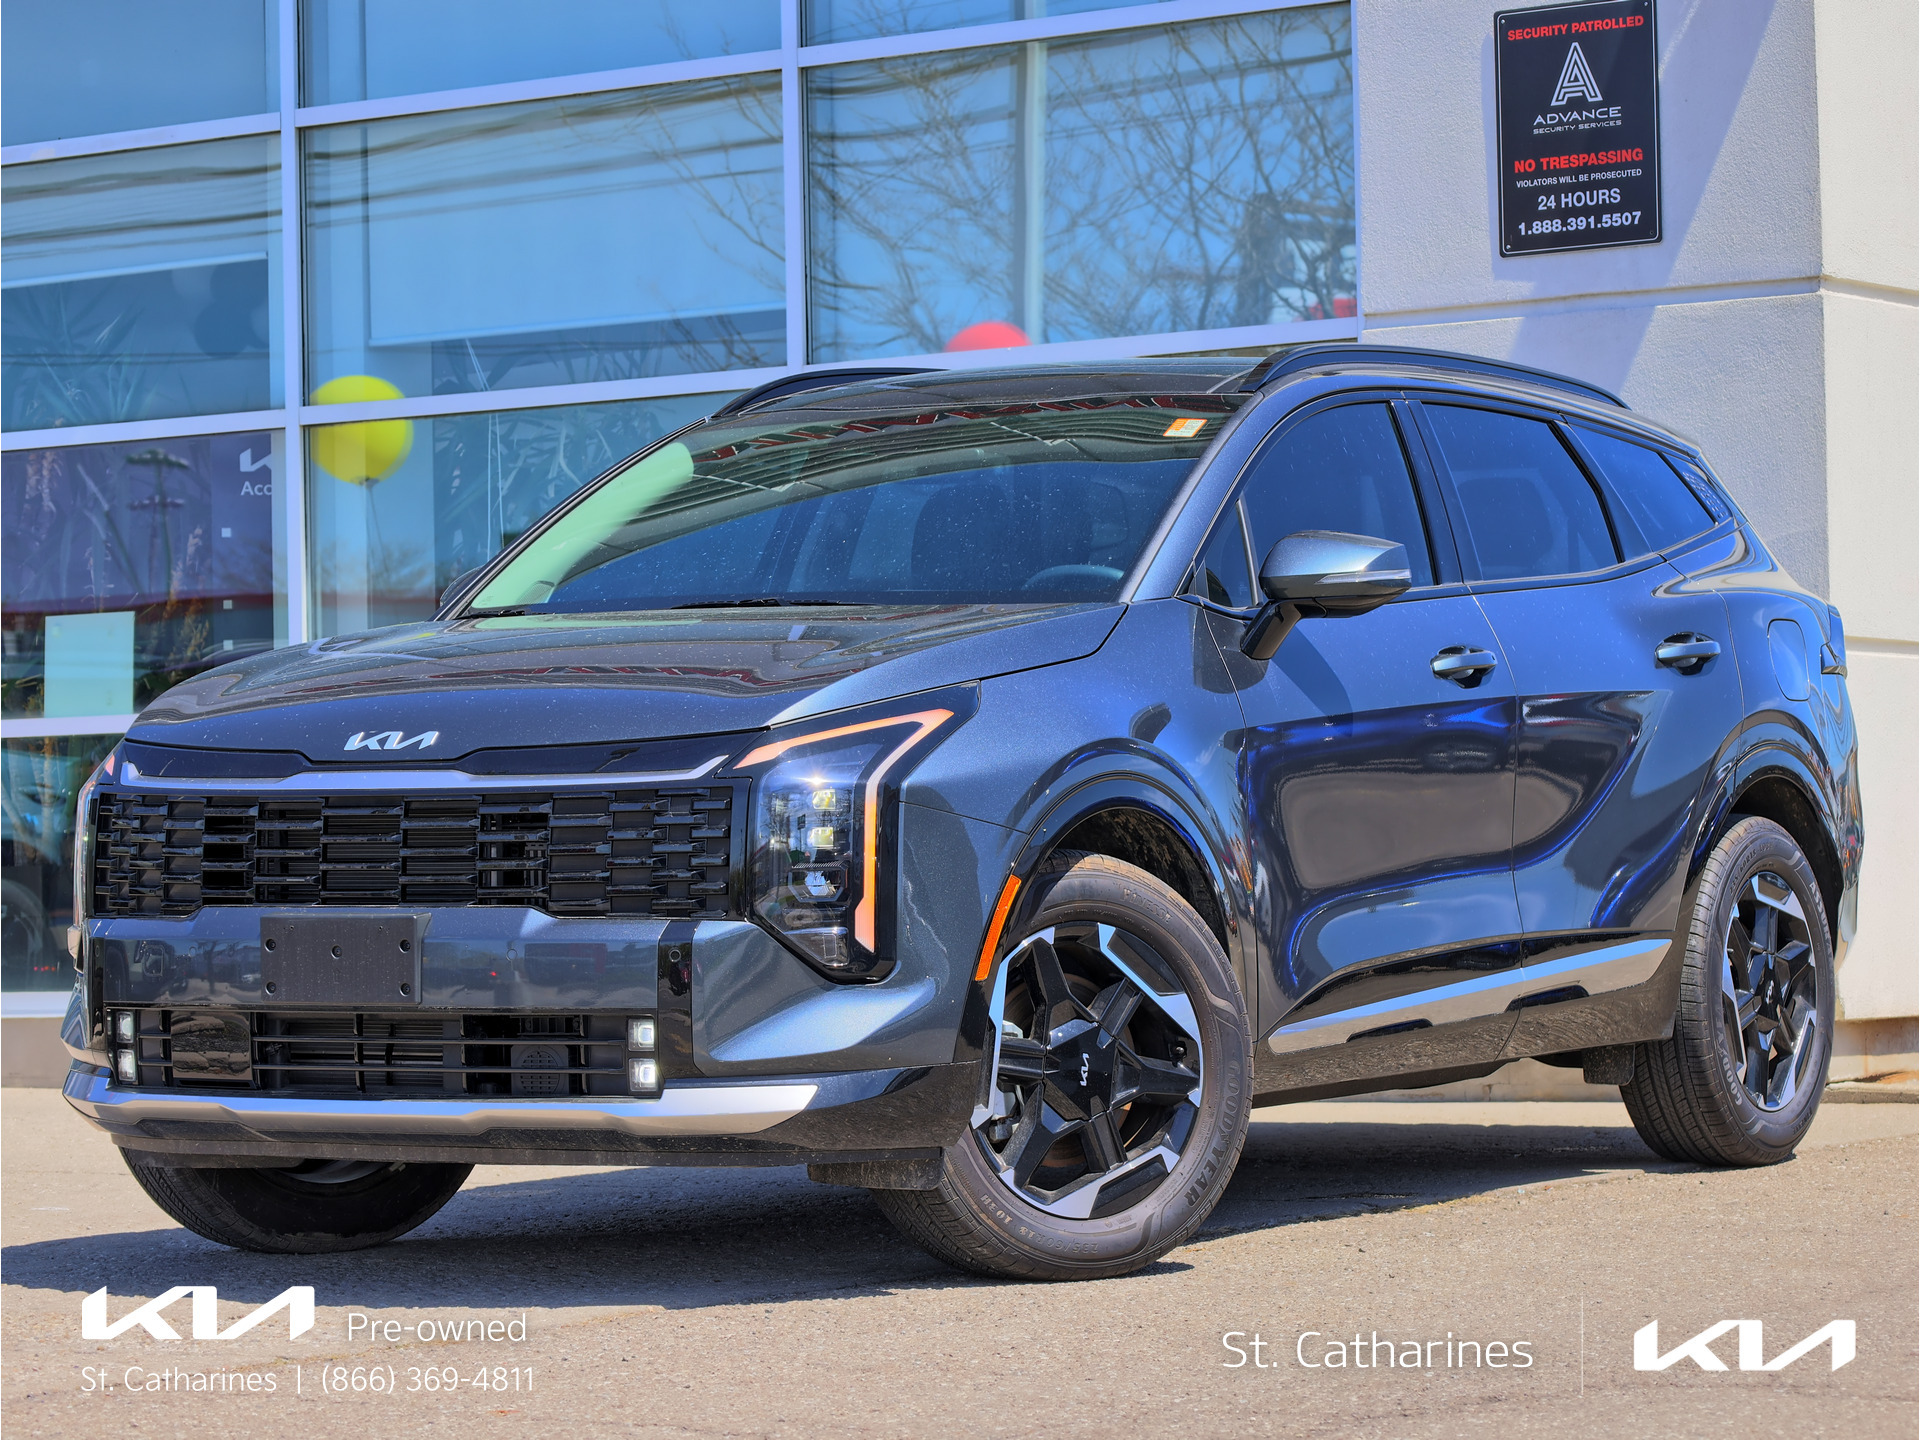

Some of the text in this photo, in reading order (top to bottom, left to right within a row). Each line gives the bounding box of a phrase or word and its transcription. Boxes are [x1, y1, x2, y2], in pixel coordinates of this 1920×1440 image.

[1507, 15, 1644, 41] SECURITY PATROLLED
[1533, 106, 1622, 126] ADVANCE
[1533, 119, 1622, 135] SECURITY SERVICES
[1514, 148, 1643, 174] NO TRESPASSING
[1516, 168, 1642, 188] VIOLATORS WILL BE PROSECUTED
[1537, 188, 1621, 211] 24 HOURS
[1519, 211, 1642, 235] 1.888.391.5507
[1184, 1059, 1241, 1208] GOODYEAR
